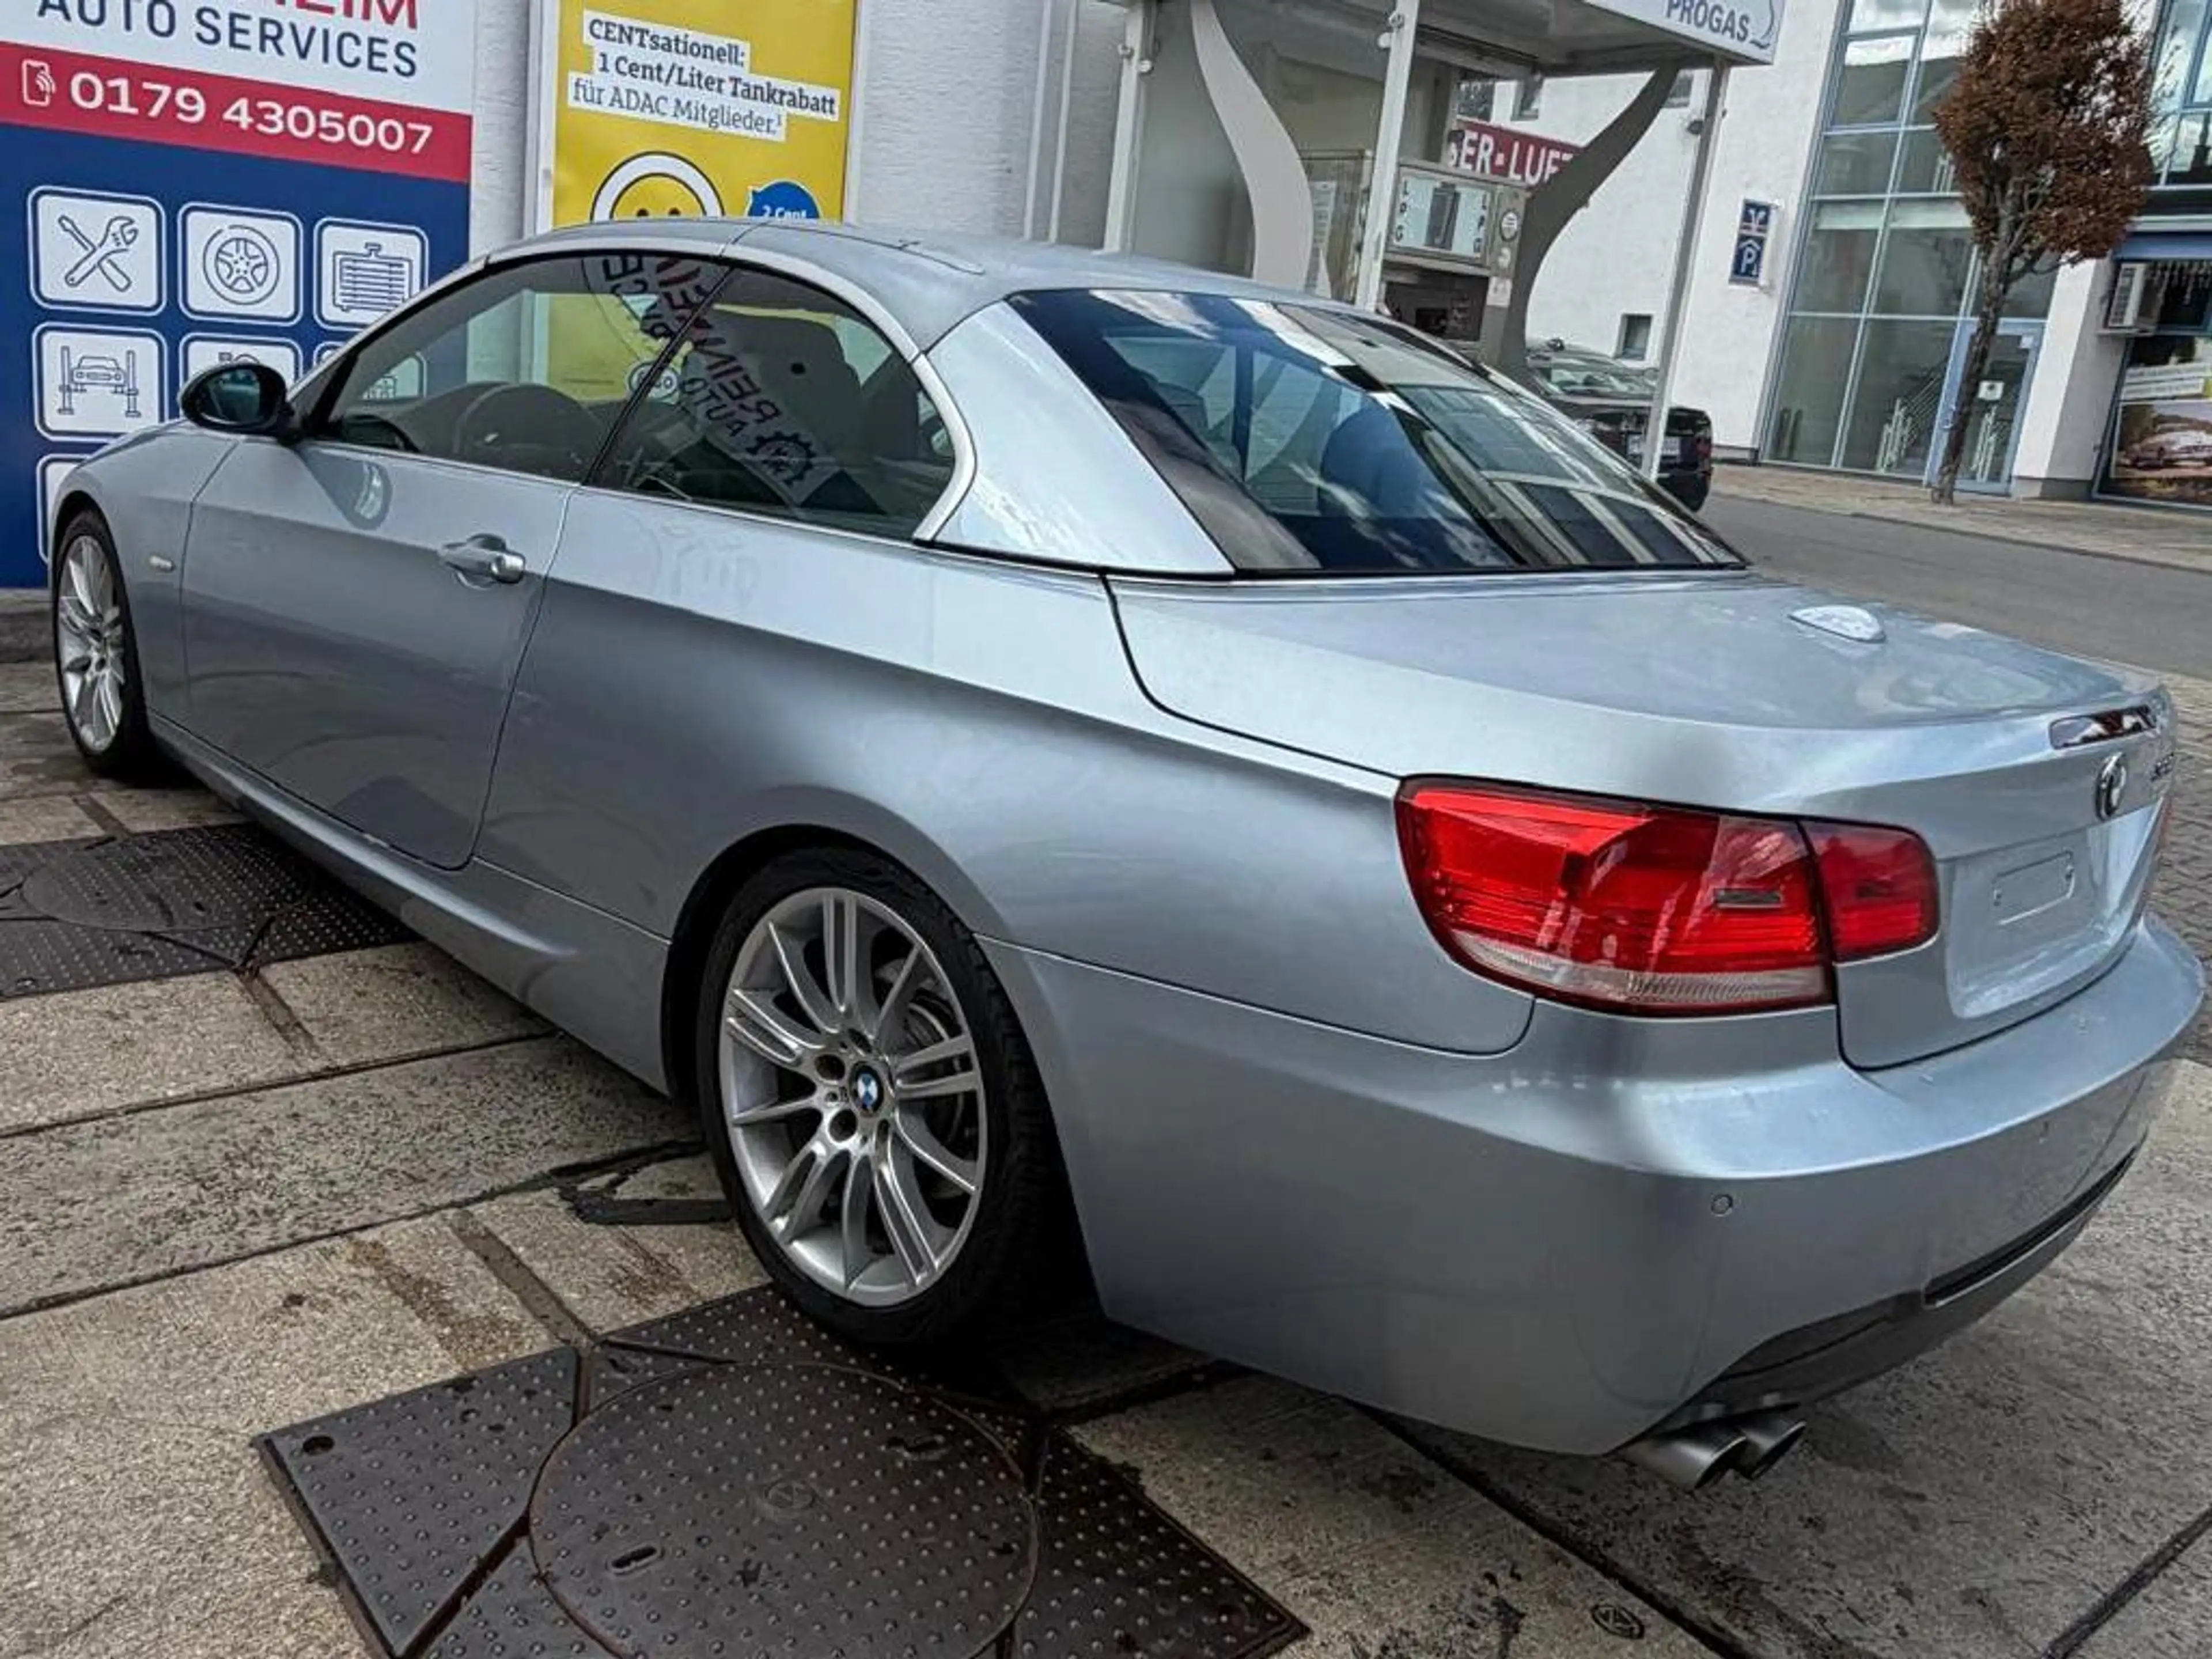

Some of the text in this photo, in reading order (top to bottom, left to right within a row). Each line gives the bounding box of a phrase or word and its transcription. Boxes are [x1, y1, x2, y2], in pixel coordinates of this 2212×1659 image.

[195, 7, 417, 77] SERVICES
[589, 18, 744, 67] CENTsationell:
[70, 72, 433, 154] 0179 4305007
[573, 77, 605, 105] für
[608, 86, 668, 116] ADAC
[599, 52, 835, 115] 1 Cent/Liter Tankrabatt
